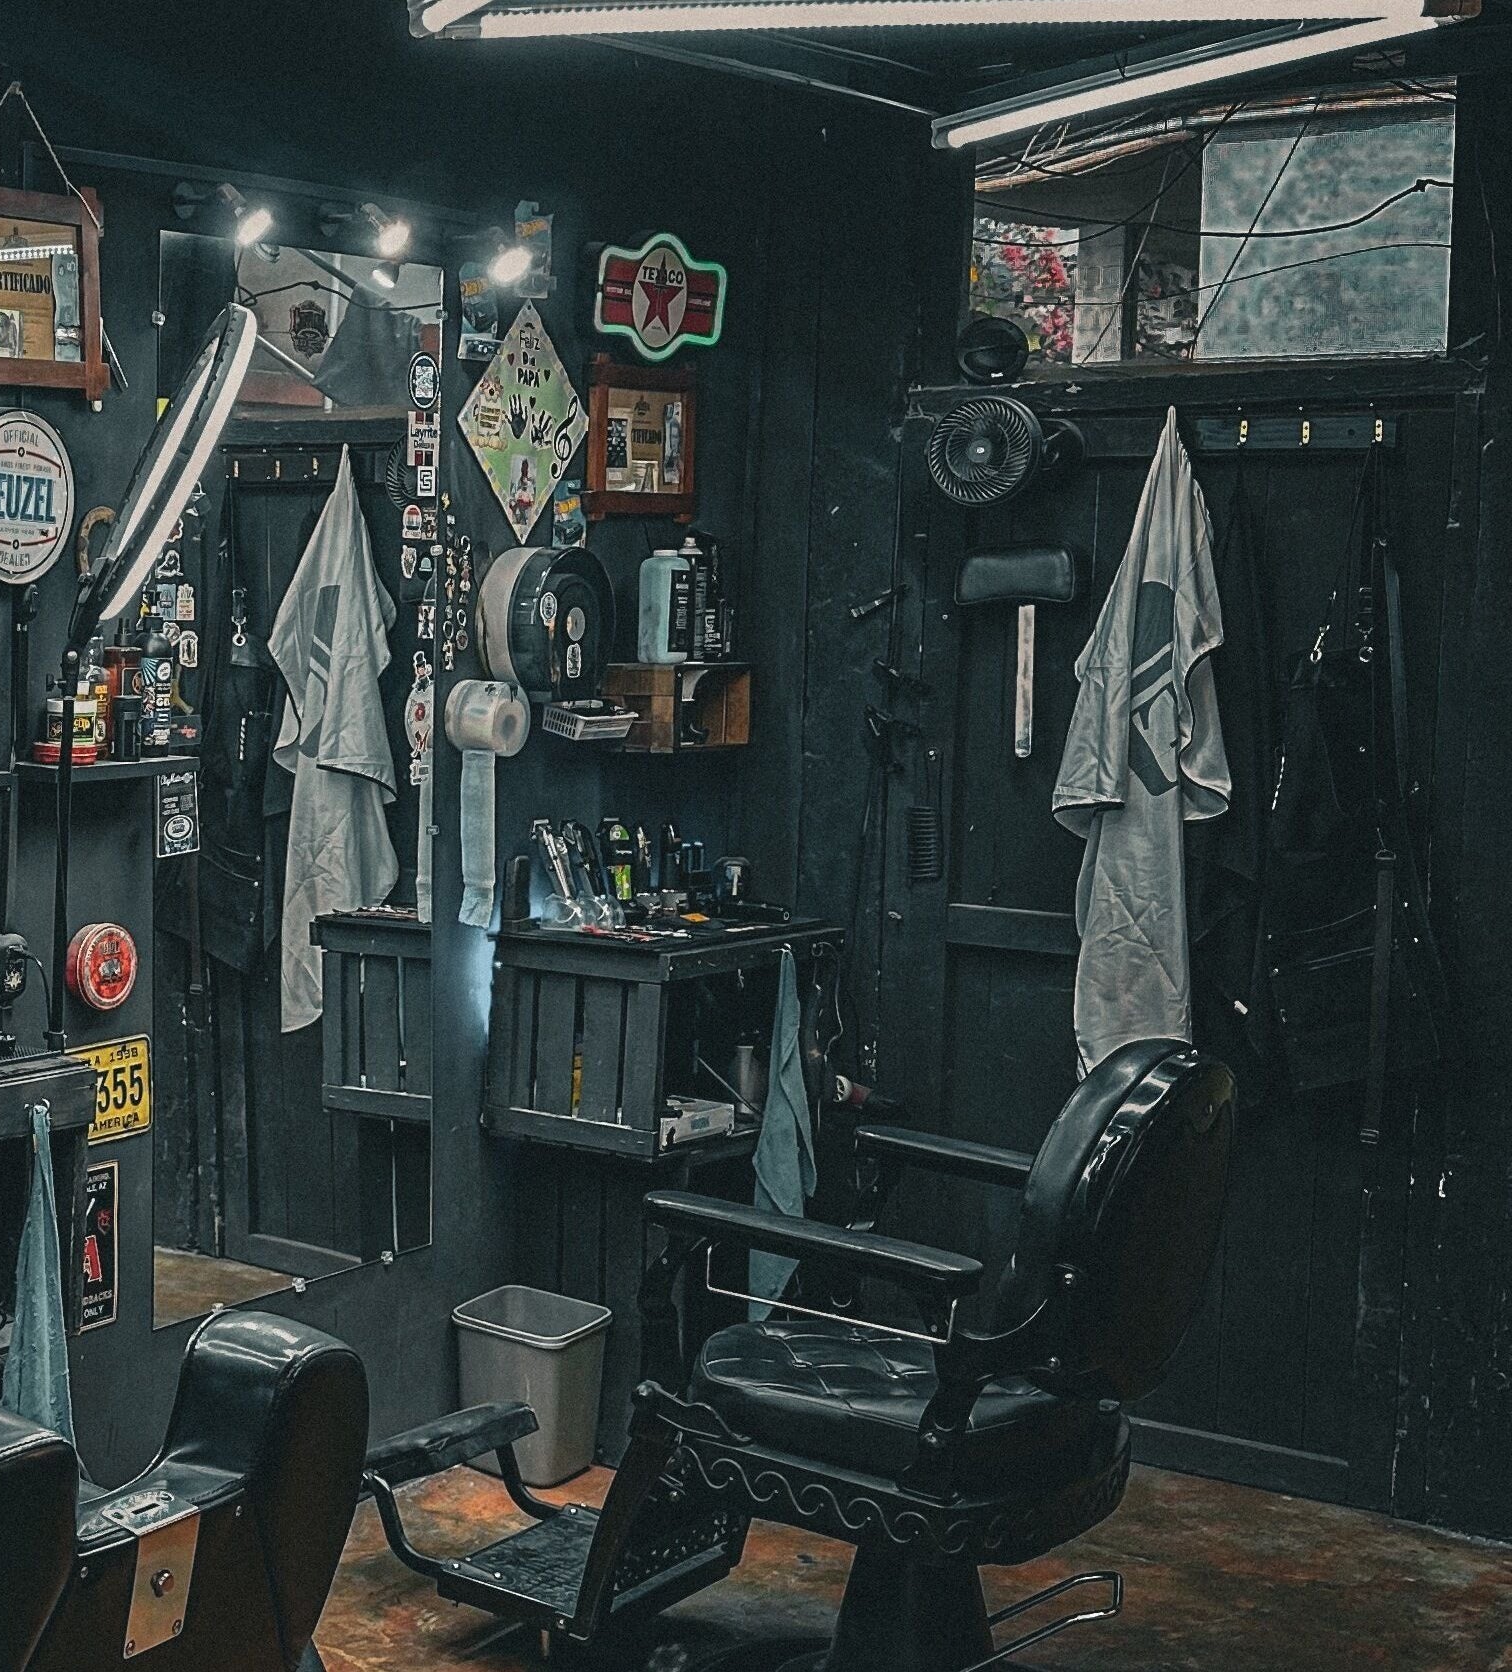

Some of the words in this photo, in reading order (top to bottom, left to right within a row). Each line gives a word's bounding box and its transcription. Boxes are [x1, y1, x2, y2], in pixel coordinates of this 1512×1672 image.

[3, 429, 39, 447] OFFICIAL
[410, 424, 438, 441] Layrite
[91, 1111, 140, 1133] AMERICA
[83, 1304, 105, 1319] ONLY
